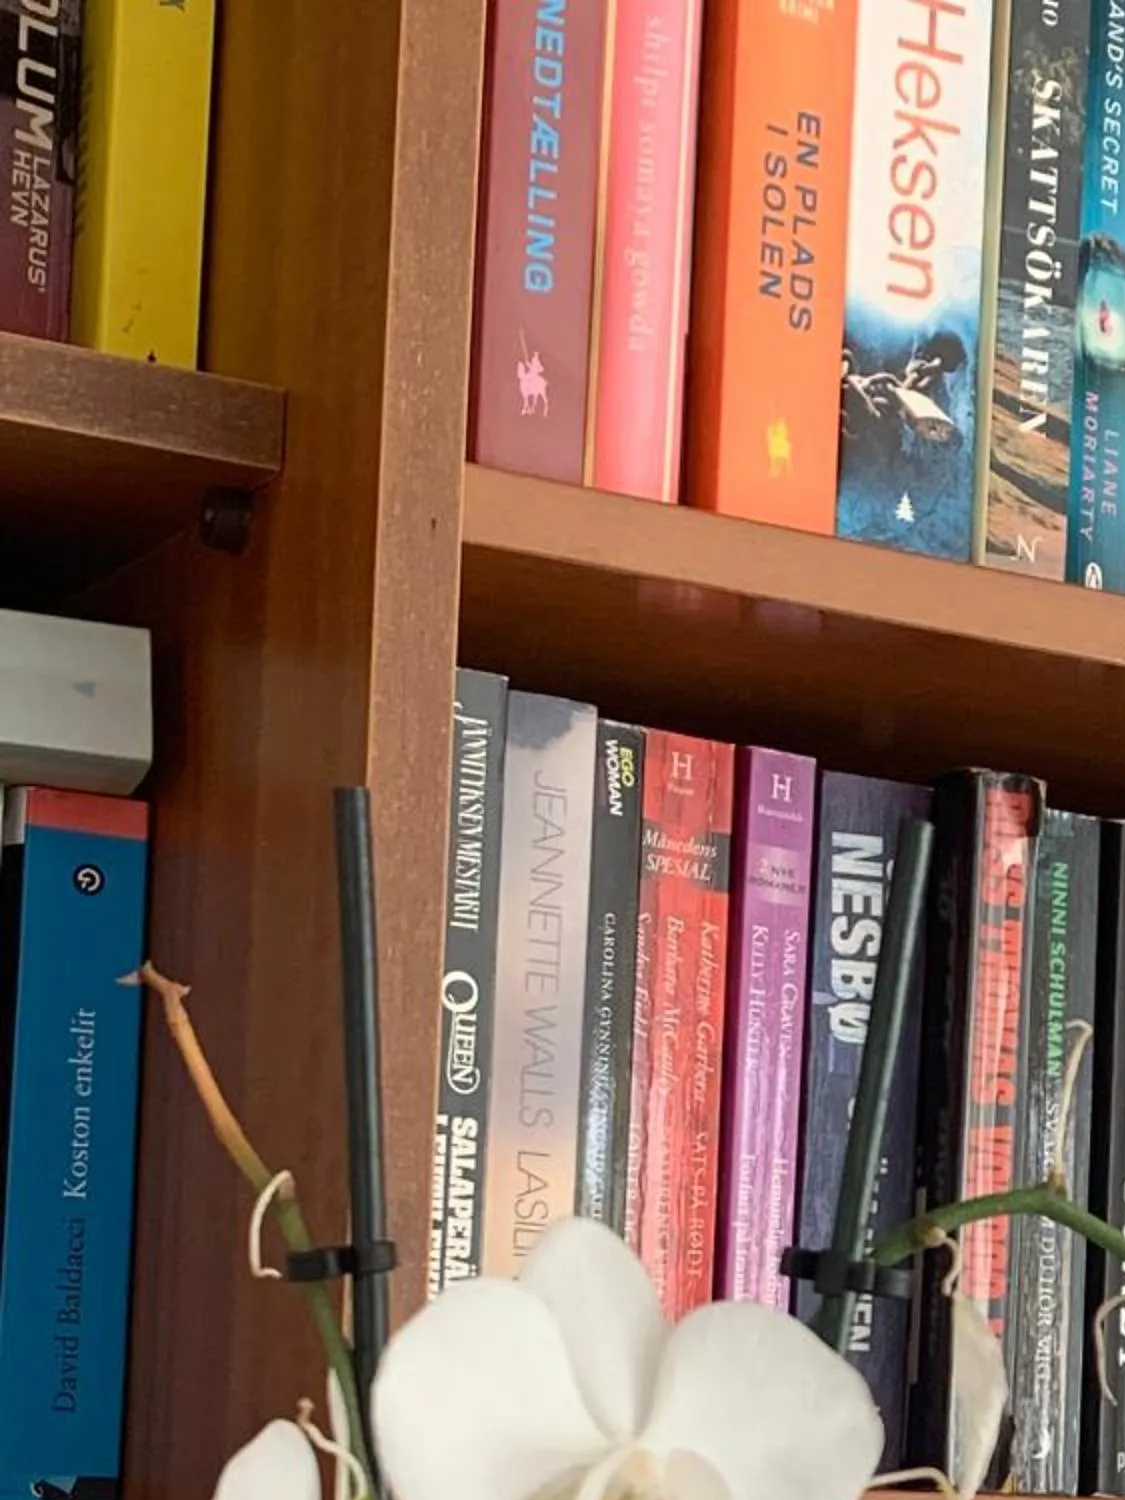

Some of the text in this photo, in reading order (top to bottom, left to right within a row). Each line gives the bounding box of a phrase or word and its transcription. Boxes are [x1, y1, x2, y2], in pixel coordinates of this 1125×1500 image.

[10, 148, 33, 228] HEVN
[758, 152, 788, 299] SOLEN
[788, 111, 821, 332] EN PLADS
[886, 0, 966, 300] Heksen
[1101, 97, 1123, 216] SECRET
[1018, 70, 1063, 438] SKATTSÖKAREN
[1078, 391, 1121, 543] LIANE MORIARTY
[604, 739, 624, 817] WOMAN
[619, 748, 634, 788] EGO
[517, 770, 568, 1128] JEANNETTE WALLS
[600, 912, 617, 1001] CAROLINA
[750, 924, 769, 983] KELLY
[777, 928, 801, 1061] SARA CRAVEN
[1047, 860, 1068, 1078] NINNI SCHULMAN
[61, 1006, 97, 1201] Koston enkelit
[440, 971, 481, 1287] QUEEN SALAPERÄ
[51, 1216, 88, 1414] David Baldacci
